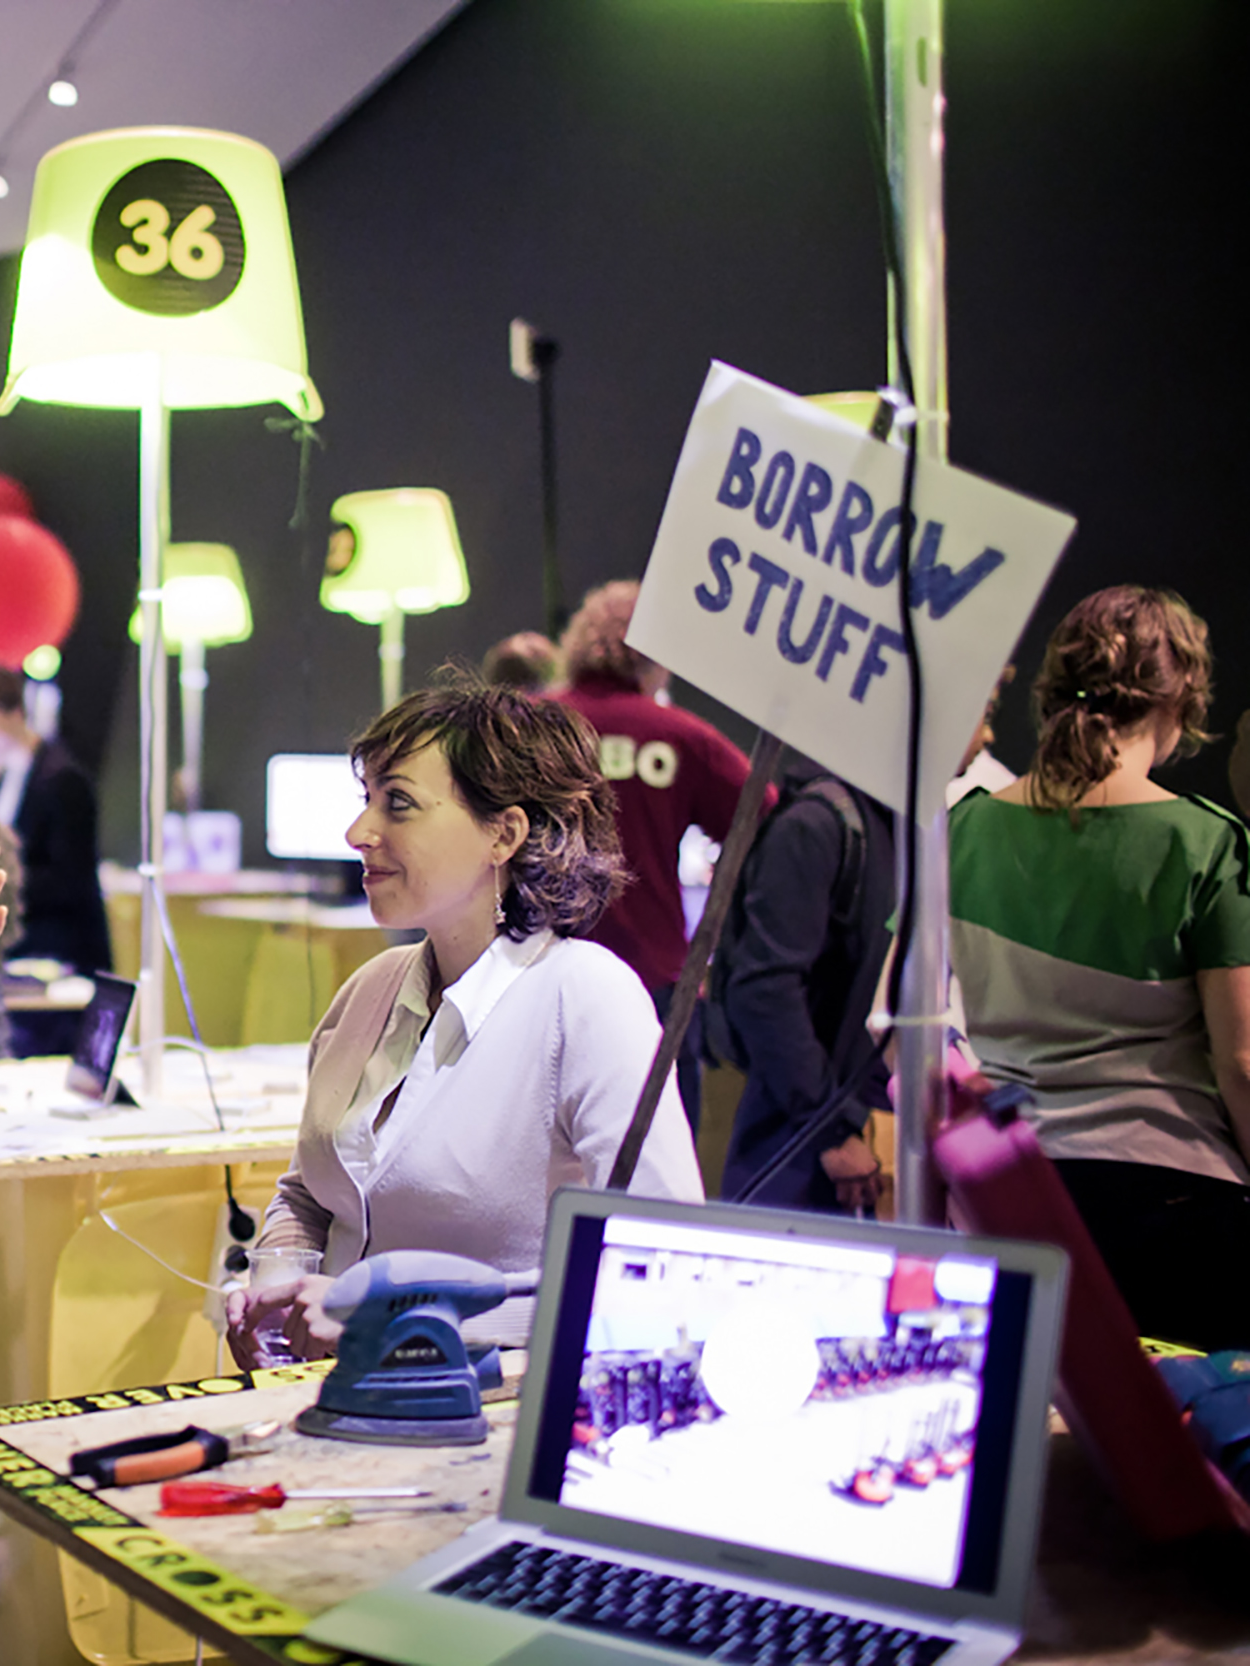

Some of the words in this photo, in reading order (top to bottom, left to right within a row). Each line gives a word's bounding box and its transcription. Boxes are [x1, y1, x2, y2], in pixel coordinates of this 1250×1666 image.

[114, 198, 225, 280] 36
[716, 426, 1006, 621] BORROW
[694, 536, 911, 704] STUFF
[116, 1534, 284, 1624] CROSS
